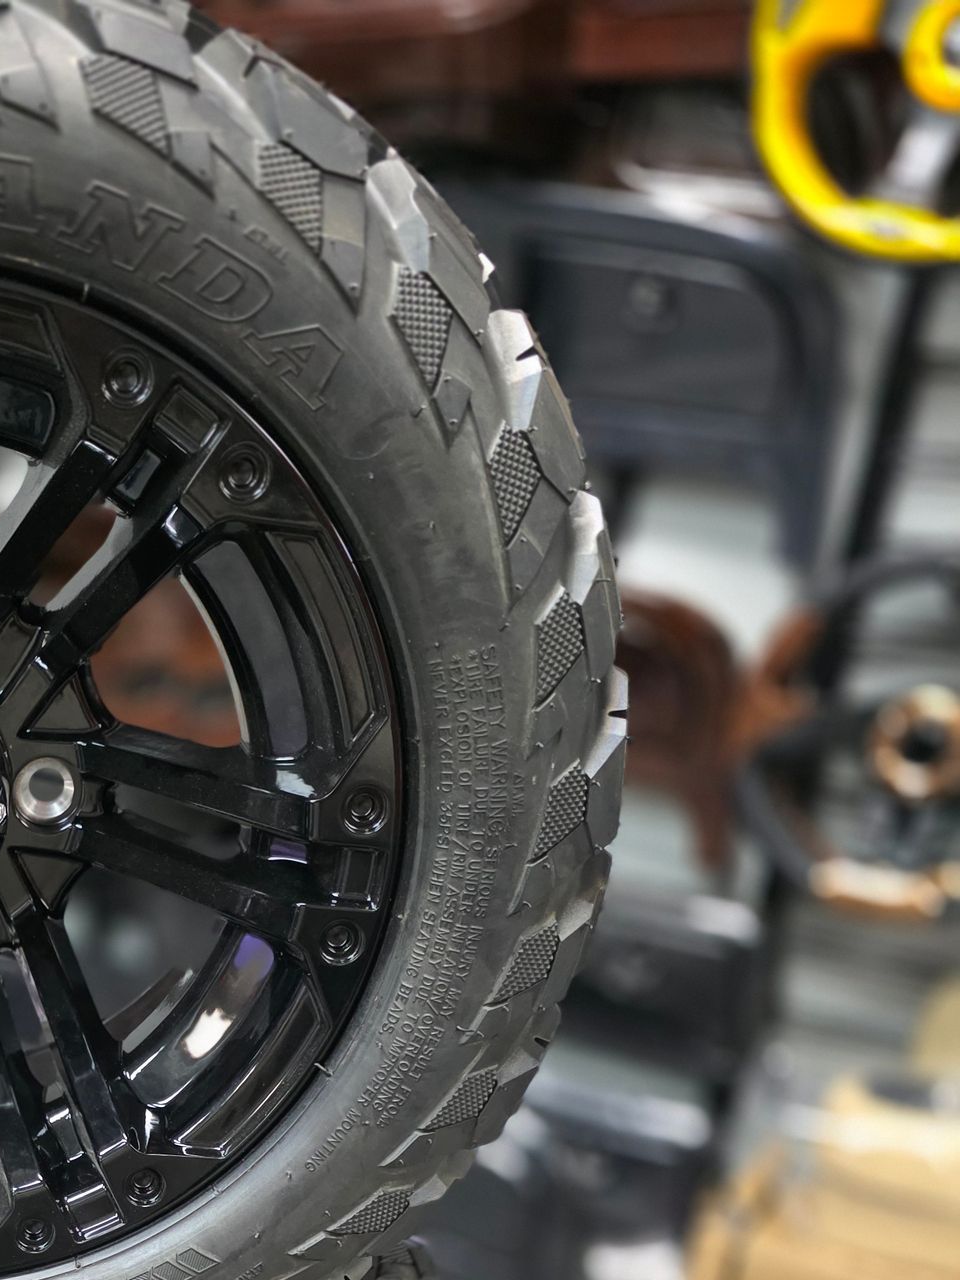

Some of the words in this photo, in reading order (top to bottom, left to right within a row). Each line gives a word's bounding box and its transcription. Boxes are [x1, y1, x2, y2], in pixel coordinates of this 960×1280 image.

[427, 659, 449, 718] NEVER
[478, 644, 506, 729] SAFETY
[436, 726, 453, 793] EXCEED
[471, 706, 488, 773] FAILURE
[458, 770, 471, 789] OF
[472, 786, 488, 818] DUE
[470, 827, 486, 851] TO
[426, 856, 448, 903] WHEN
[473, 847, 499, 918] SERIOUS
[403, 909, 438, 978] SEATING
[425, 885, 461, 968] ASSEMBLY
[453, 924, 483, 982] INJURY
[412, 973, 434, 1006] DUE
[437, 987, 461, 1020] MAY
[400, 1012, 418, 1033] TO
[355, 1035, 408, 1108] IMPROPER
[406, 1024, 445, 1081] RESULT
[302, 1108, 362, 1173] MOUNTING
